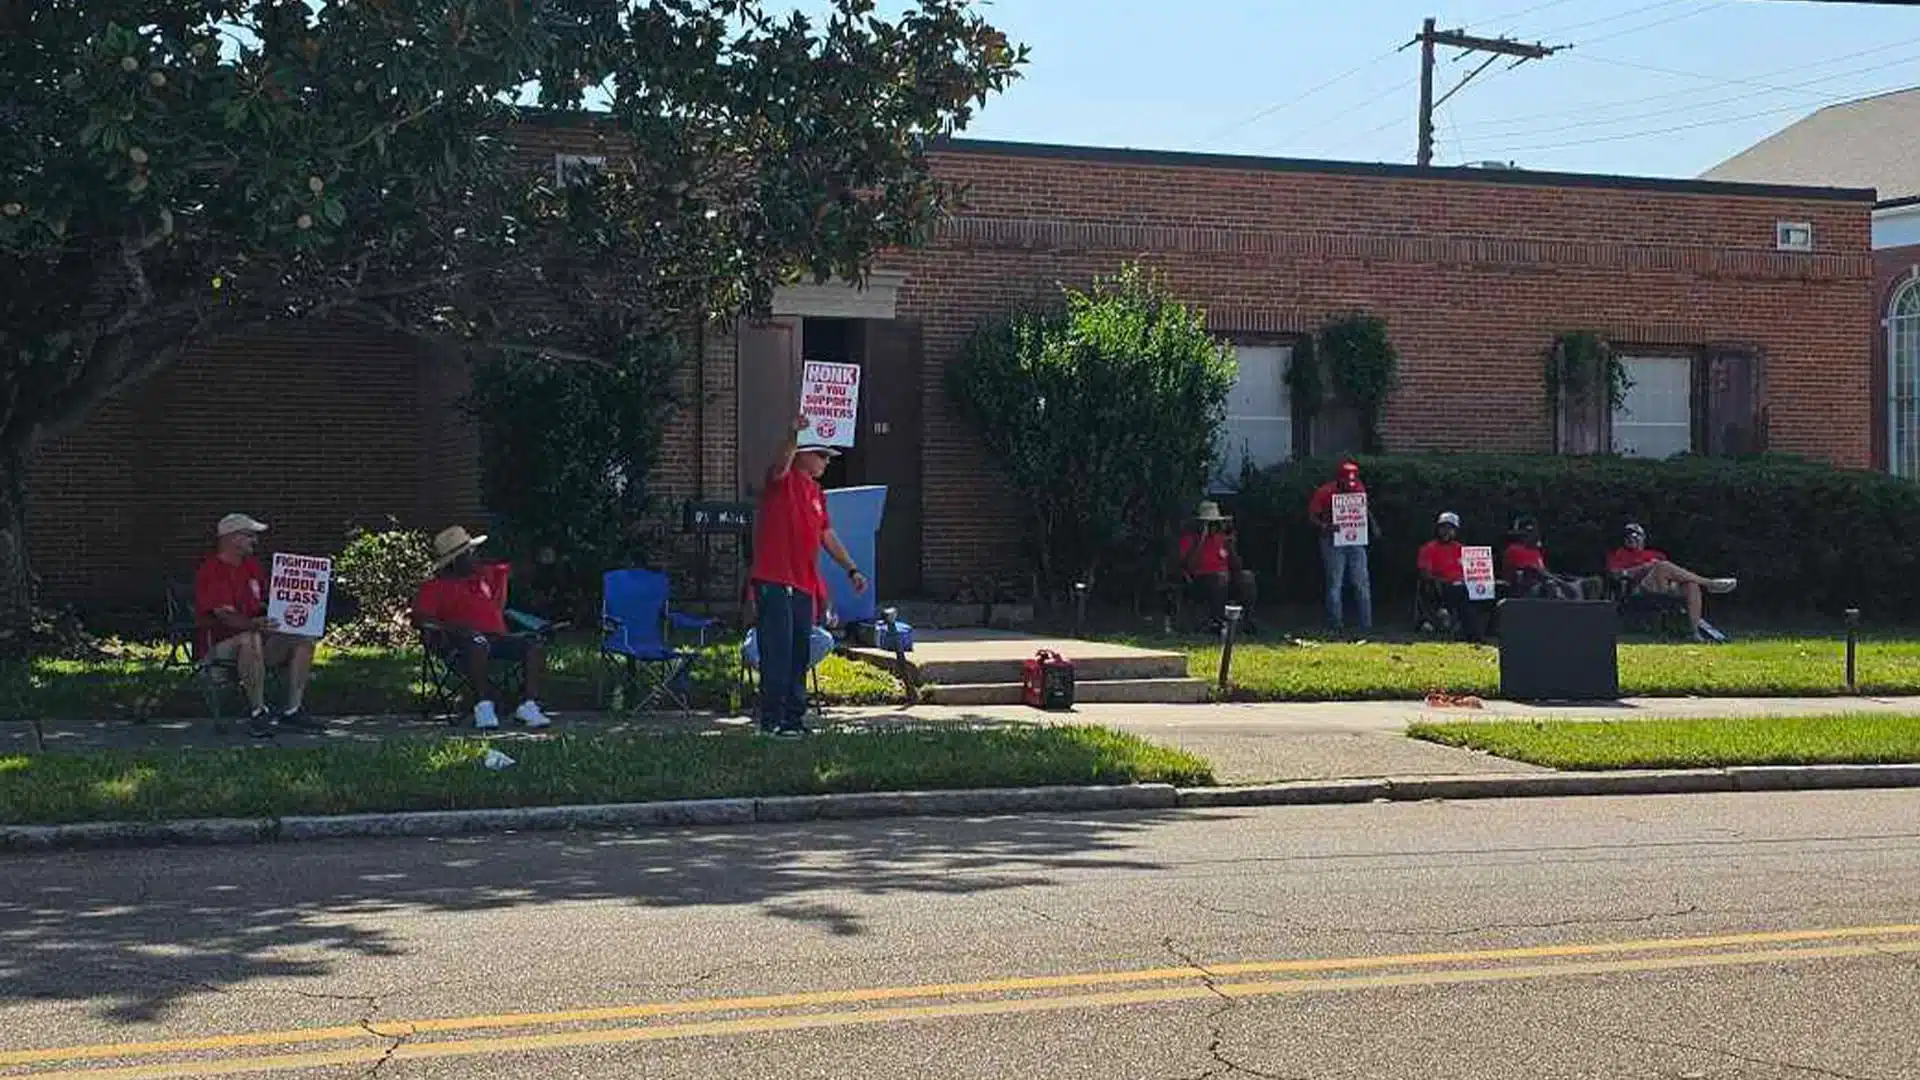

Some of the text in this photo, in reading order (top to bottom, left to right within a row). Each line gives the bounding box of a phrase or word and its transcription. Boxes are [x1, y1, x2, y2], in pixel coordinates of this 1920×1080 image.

[807, 365, 856, 384] HONK
[826, 384, 846, 396] YOU
[275, 555, 328, 572] FIGHTING
[284, 568, 299, 577] FOR
[273, 576, 326, 594] MIDDLE
[276, 589, 320, 605] CLASS
